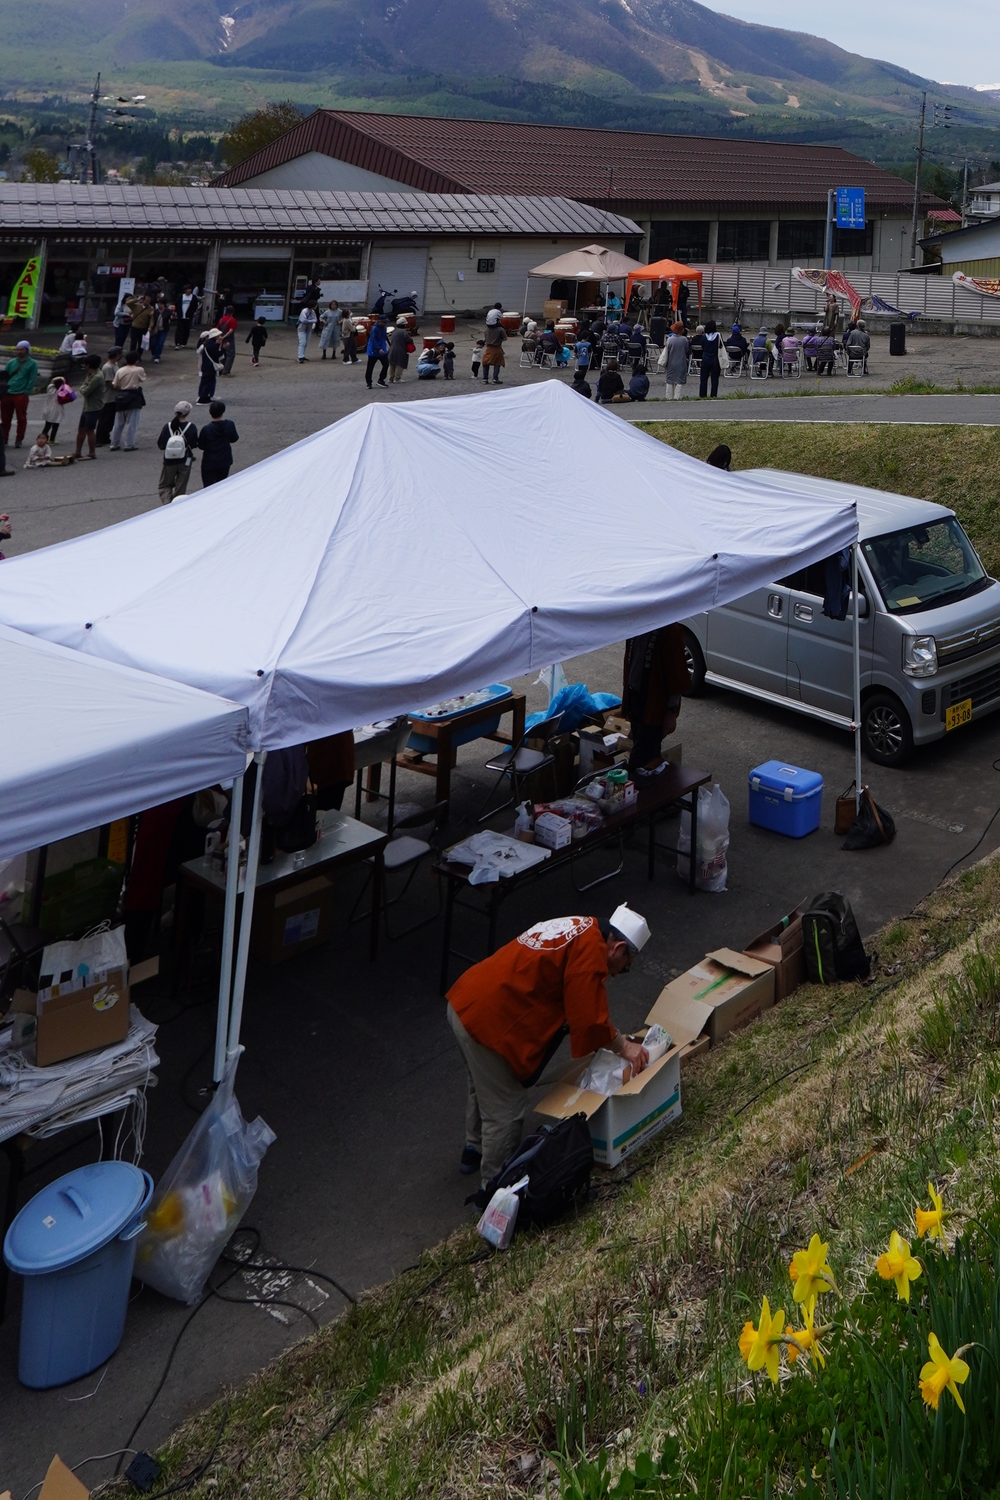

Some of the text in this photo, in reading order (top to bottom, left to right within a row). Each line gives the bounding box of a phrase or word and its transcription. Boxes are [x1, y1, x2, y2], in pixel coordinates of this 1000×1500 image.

[111, 266, 126, 274] SALE
[15, 260, 36, 315] SALE
[952, 708, 970, 726] 93-08
